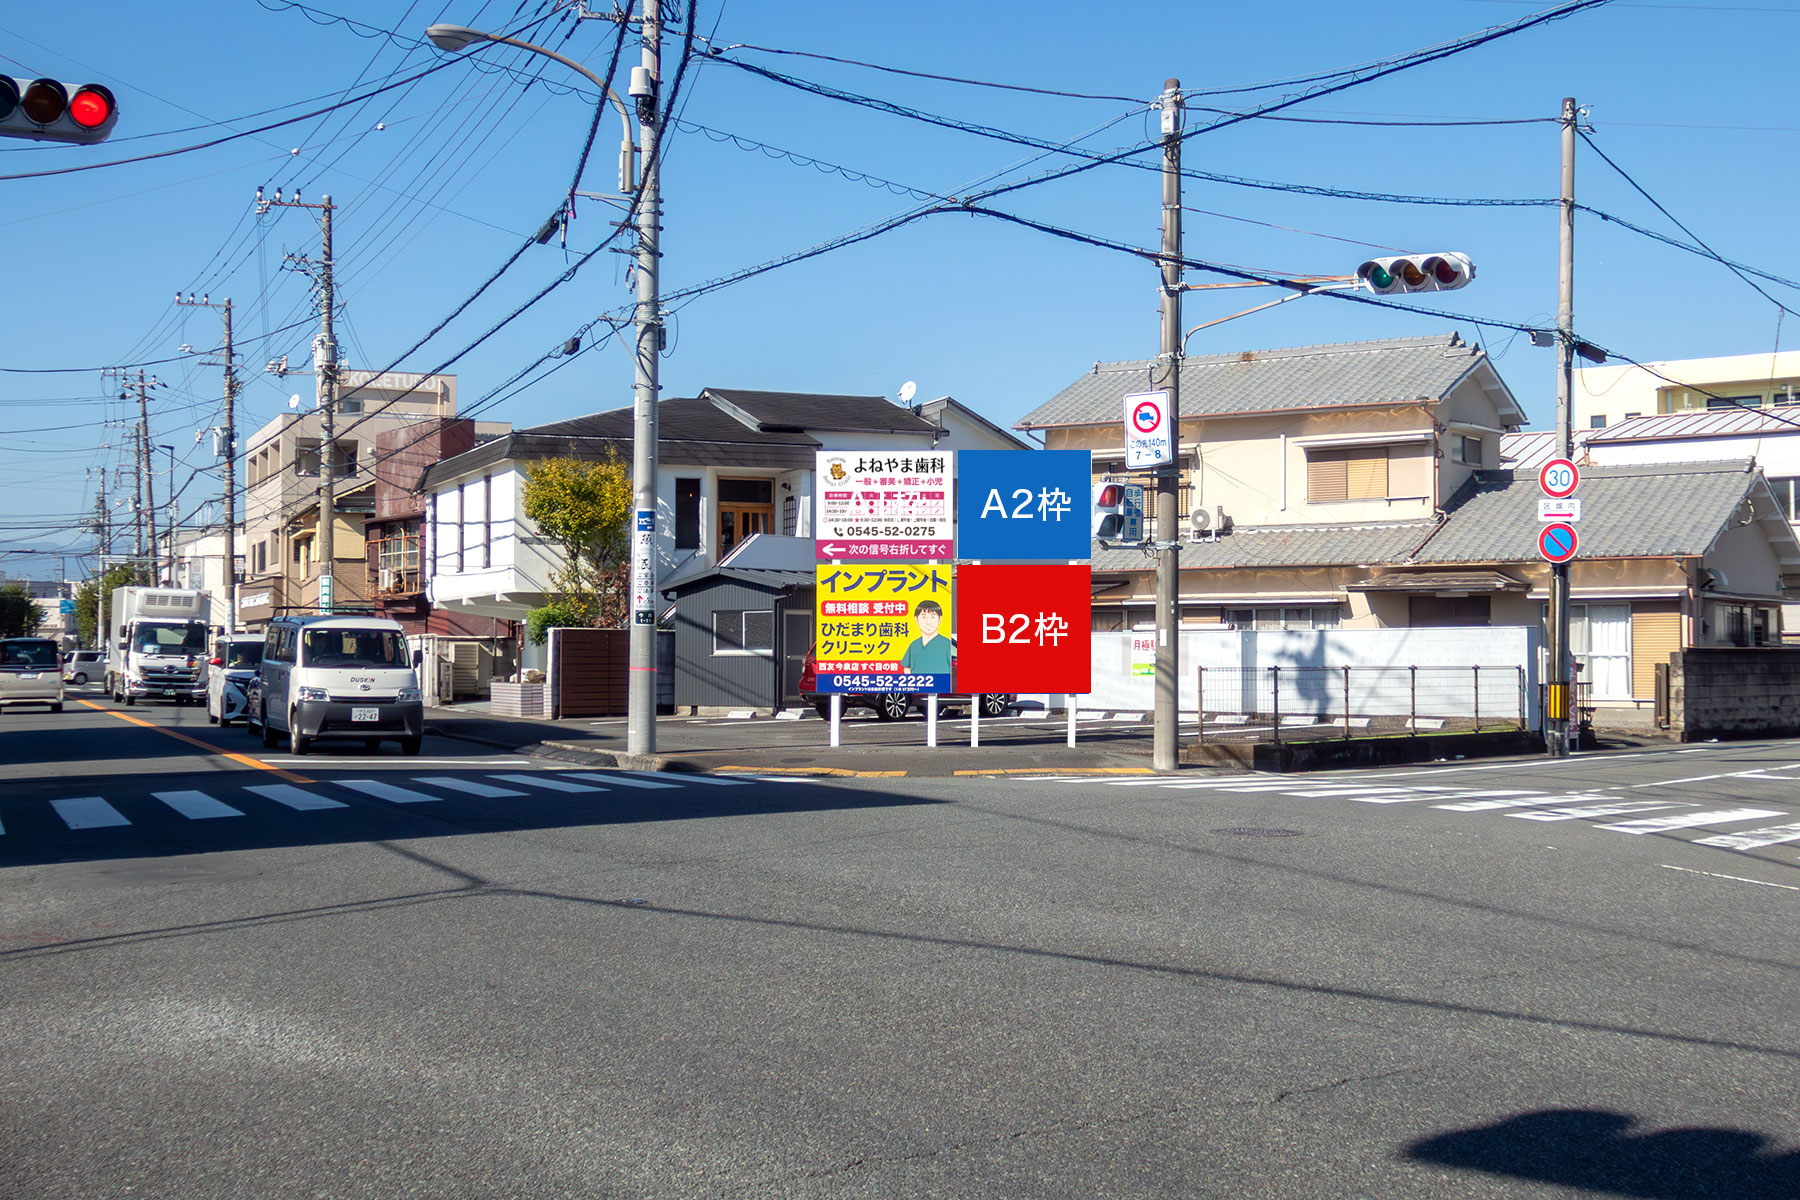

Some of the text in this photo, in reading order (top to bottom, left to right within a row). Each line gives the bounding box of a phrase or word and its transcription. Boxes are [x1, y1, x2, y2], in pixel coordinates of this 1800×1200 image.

[854, 457, 945, 473] よねやま歯科
[1548, 470, 1570, 487] 30
[847, 527, 935, 536] 0545-52-0275
[848, 544, 946, 555] 次の信号右折してすぐ
[820, 569, 947, 593] インプラント
[825, 603, 906, 614] 無料相談 受付中
[821, 622, 909, 637] ひだまり歯科
[821, 640, 890, 655] クリニック
[861, 662, 898, 671] すぐ目の前
[833, 675, 934, 687] 0545-52-2222
